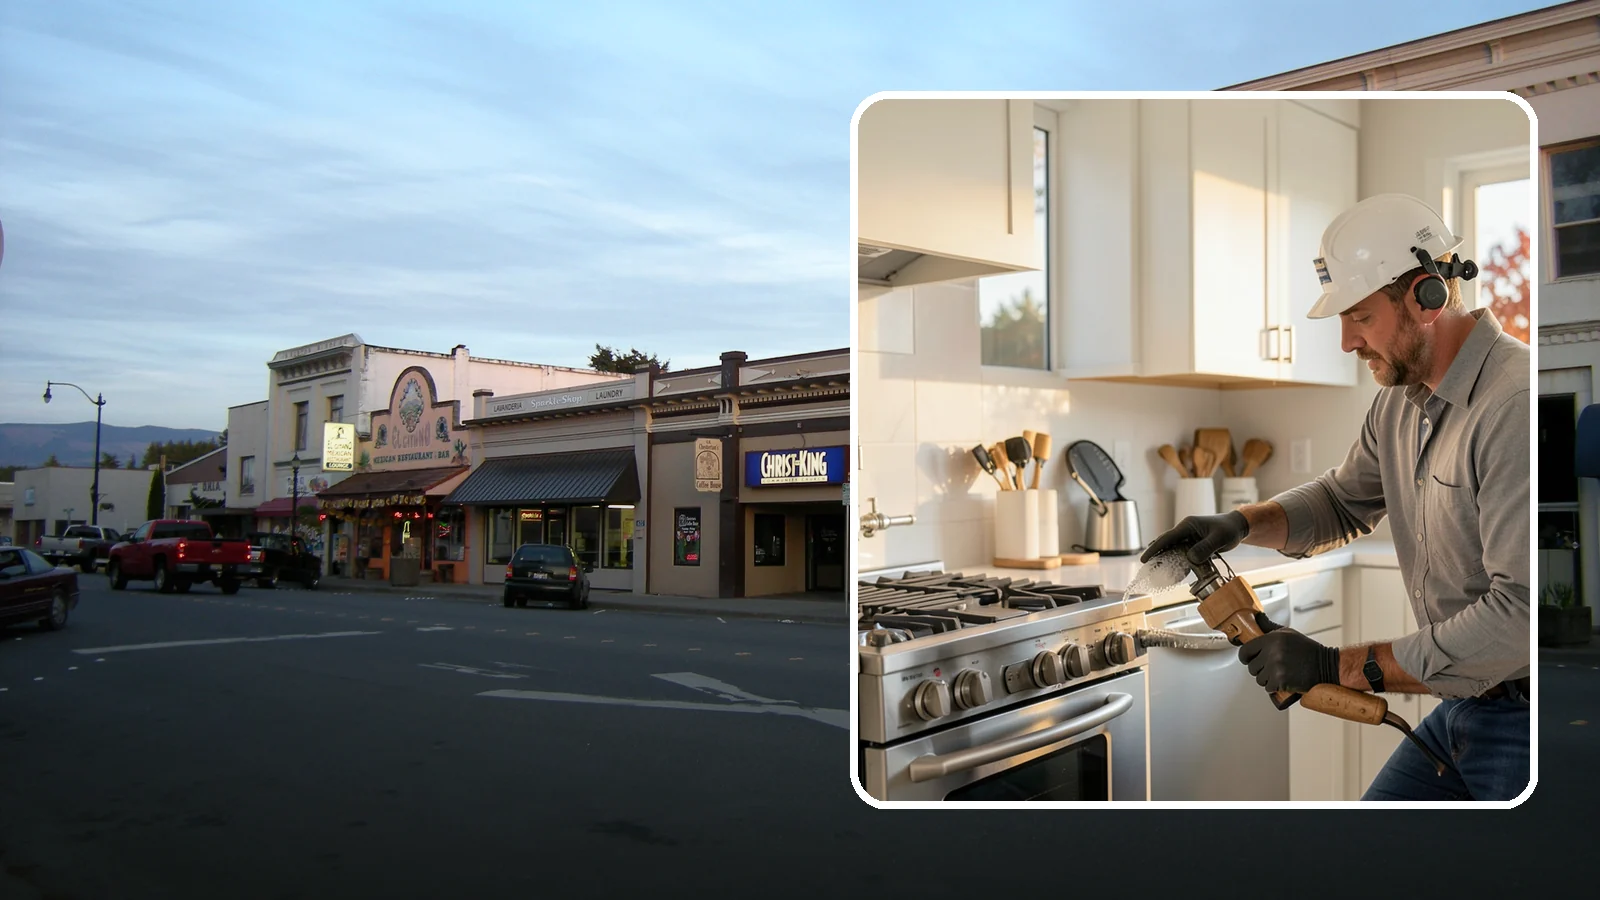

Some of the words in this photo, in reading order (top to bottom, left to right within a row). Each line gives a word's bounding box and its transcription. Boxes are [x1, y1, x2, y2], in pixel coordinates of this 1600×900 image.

[562, 394, 582, 404] Shop
[595, 389, 624, 400] LAUNDRY
[493, 402, 523, 413] LAVANDERIA
[373, 454, 397, 464] MEXICAN
[397, 451, 433, 462] RESTAURANT
[437, 450, 450, 459] BAR
[761, 452, 797, 478] CHRIST
[799, 450, 828, 477] KING
